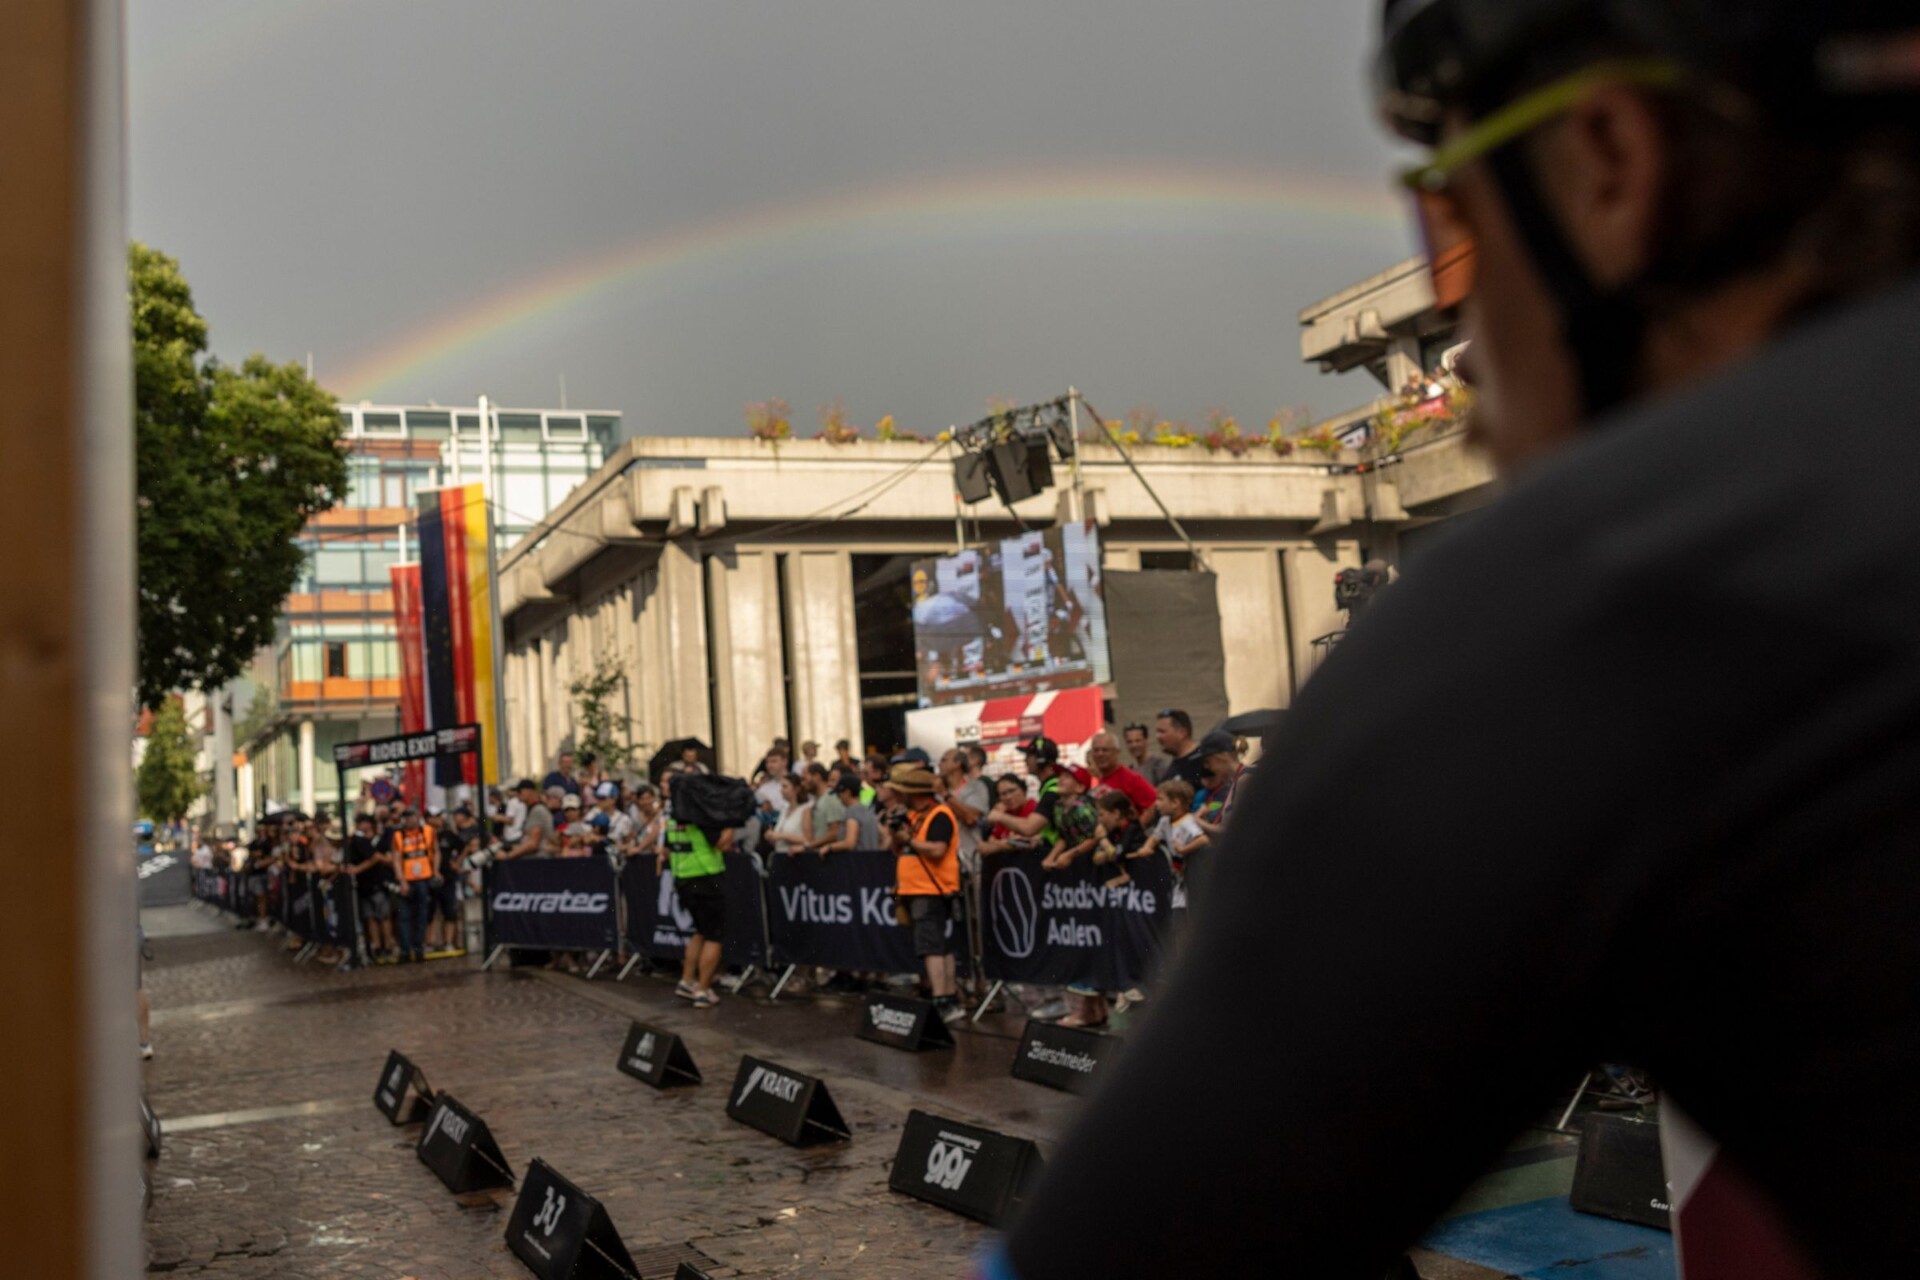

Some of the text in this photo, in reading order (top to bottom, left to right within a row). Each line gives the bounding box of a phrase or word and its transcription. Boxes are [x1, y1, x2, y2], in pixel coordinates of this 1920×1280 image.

[369, 740, 406, 763] RIDER
[408, 735, 436, 757] EXIT
[493, 890, 609, 913] corratec
[779, 884, 853, 924] Vitus
[1047, 915, 1102, 947] Aalen
[760, 1070, 804, 1103] KRATKY
